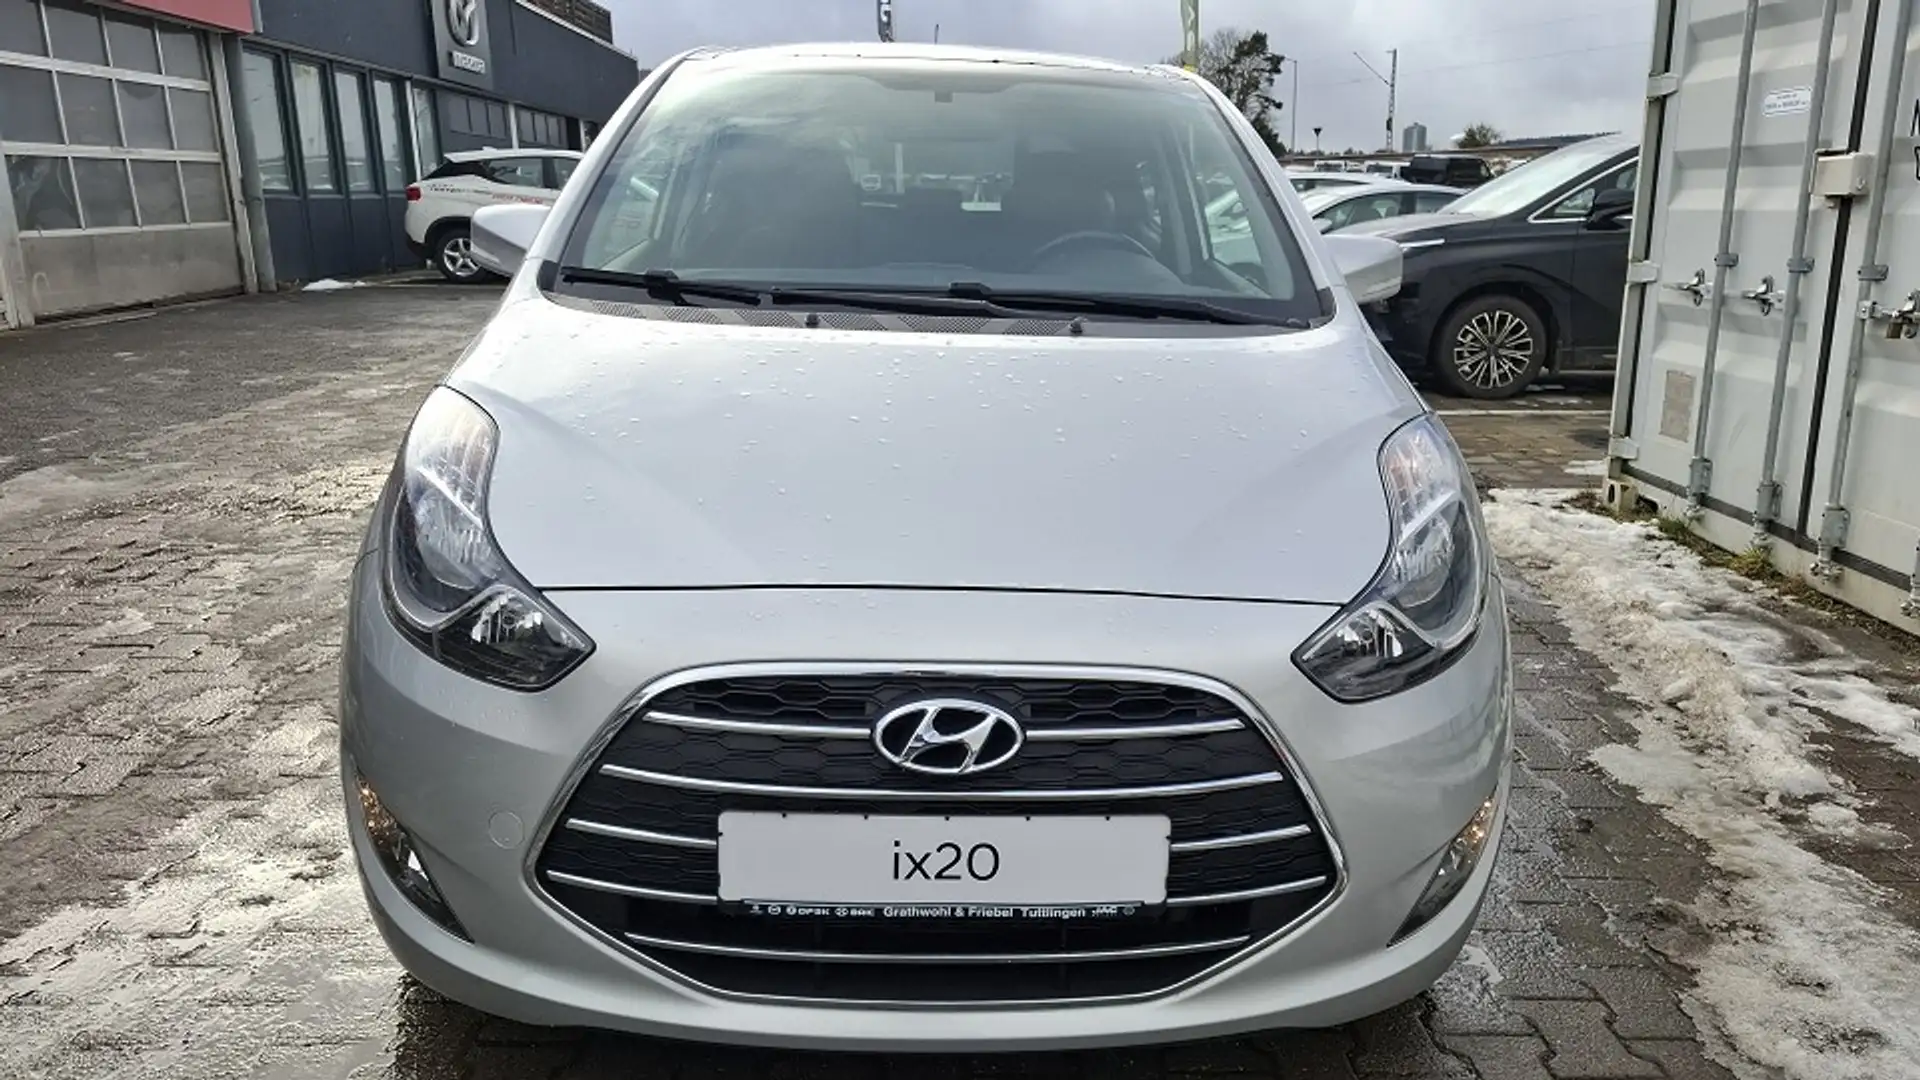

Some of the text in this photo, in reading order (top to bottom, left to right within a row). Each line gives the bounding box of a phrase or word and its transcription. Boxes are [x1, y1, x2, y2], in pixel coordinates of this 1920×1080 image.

[893, 840, 1000, 881] ix20
[883, 906, 951, 917] Grathwohl
[954, 907, 965, 917] &
[968, 906, 1013, 918] Friebel
